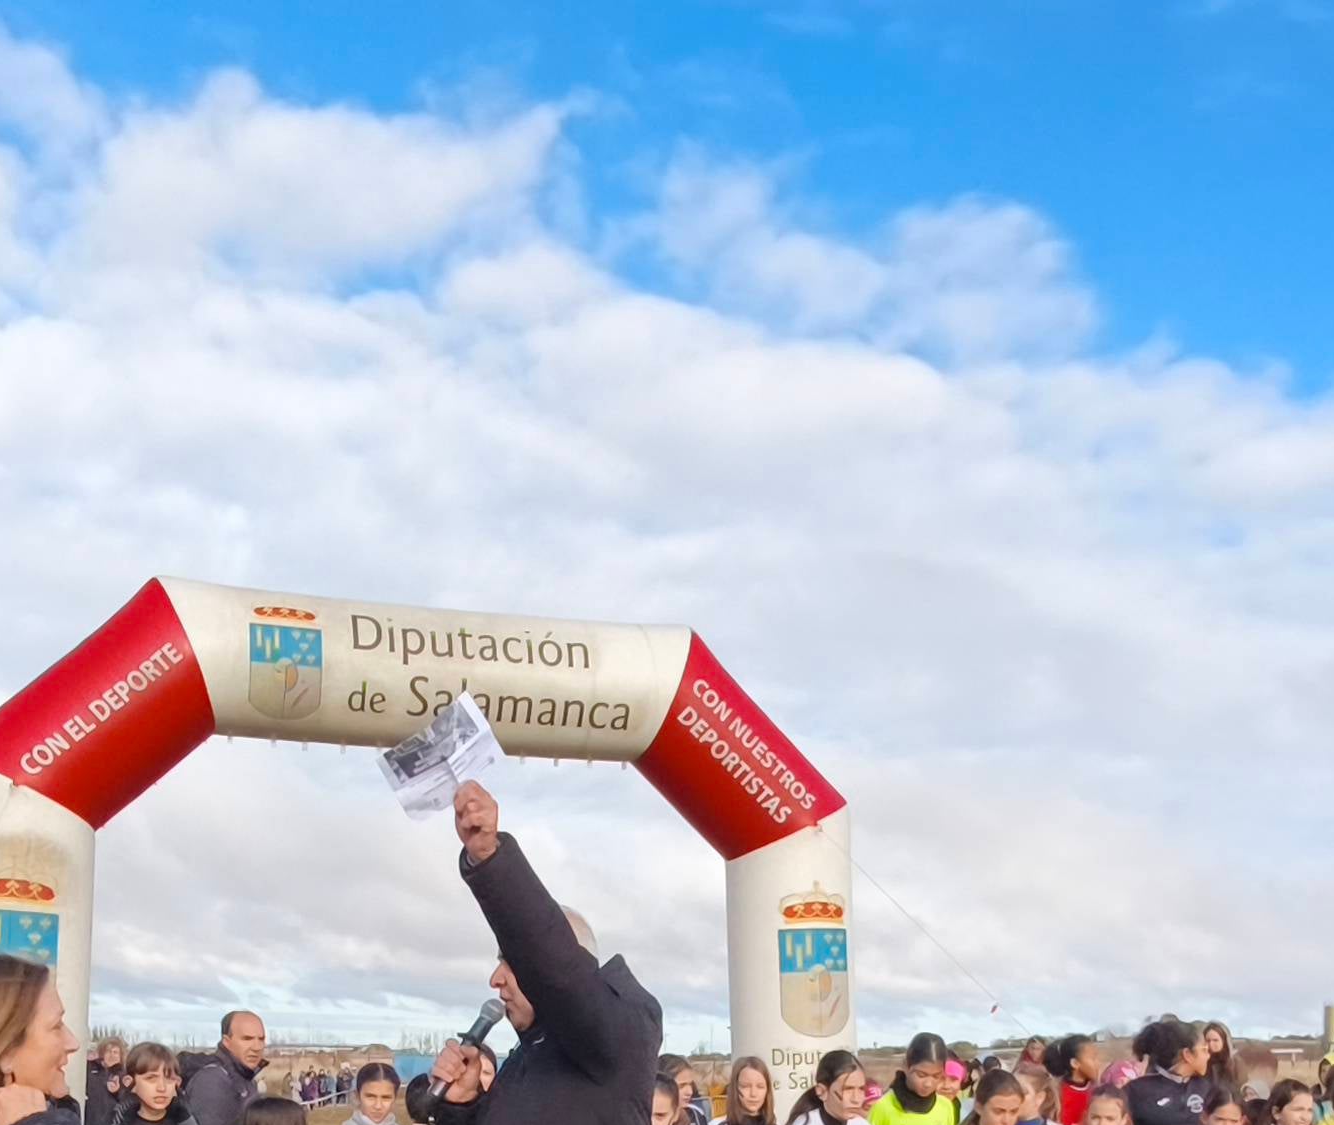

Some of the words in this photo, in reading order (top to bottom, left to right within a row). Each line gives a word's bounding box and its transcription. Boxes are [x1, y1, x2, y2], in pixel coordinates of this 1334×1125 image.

[350, 614, 590, 669] Diputación
[20, 732, 71, 775] CON
[63, 714, 98, 742] EL
[87, 641, 184, 723] DEPORTE
[347, 680, 387, 714] de
[676, 705, 793, 825] DEPORTISTAS
[692, 678, 733, 722] CON
[728, 716, 817, 810] NUESTROS
[771, 1048, 822, 1070] Diput
[773, 1080, 780, 1090] e
[788, 1072, 815, 1090] Sal
